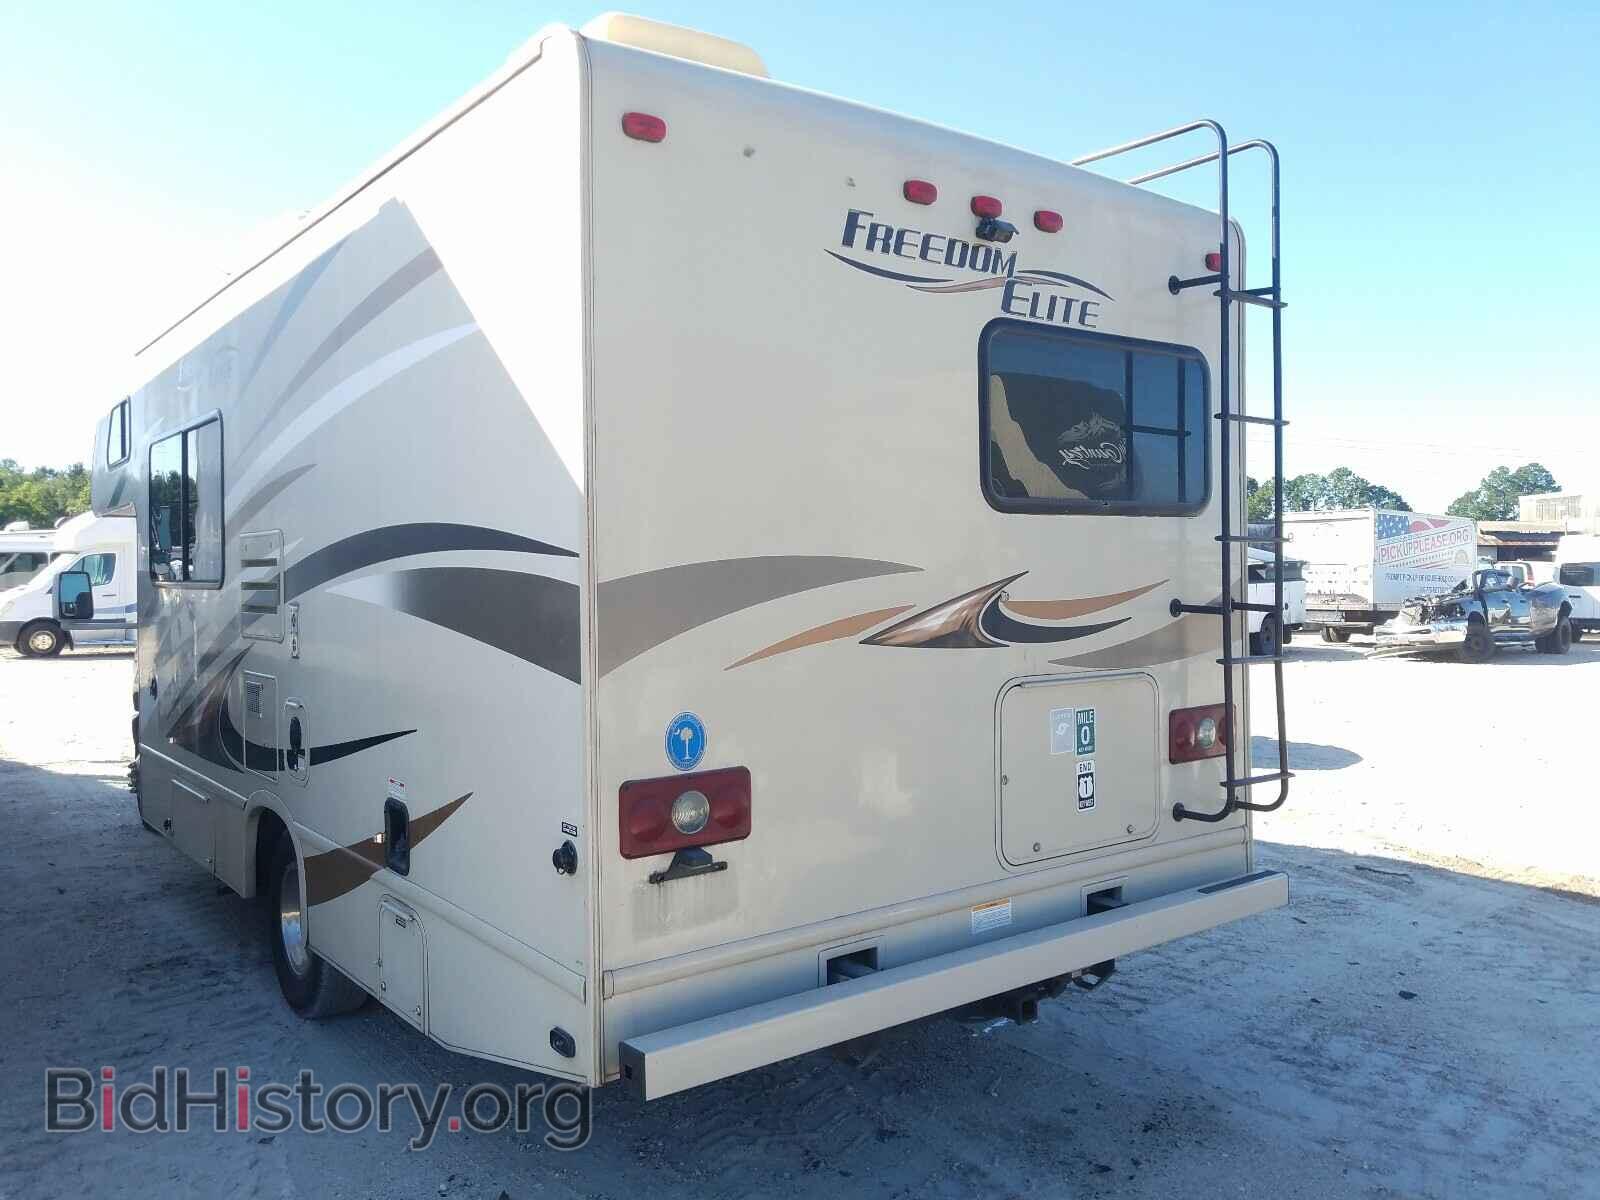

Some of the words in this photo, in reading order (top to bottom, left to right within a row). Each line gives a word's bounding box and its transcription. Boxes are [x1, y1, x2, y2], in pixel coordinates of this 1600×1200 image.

[841, 208, 1018, 279] FREEDOM
[1001, 279, 1101, 328] ELITE
[1077, 711, 1094, 725] MILE
[1080, 762, 1092, 773] END
